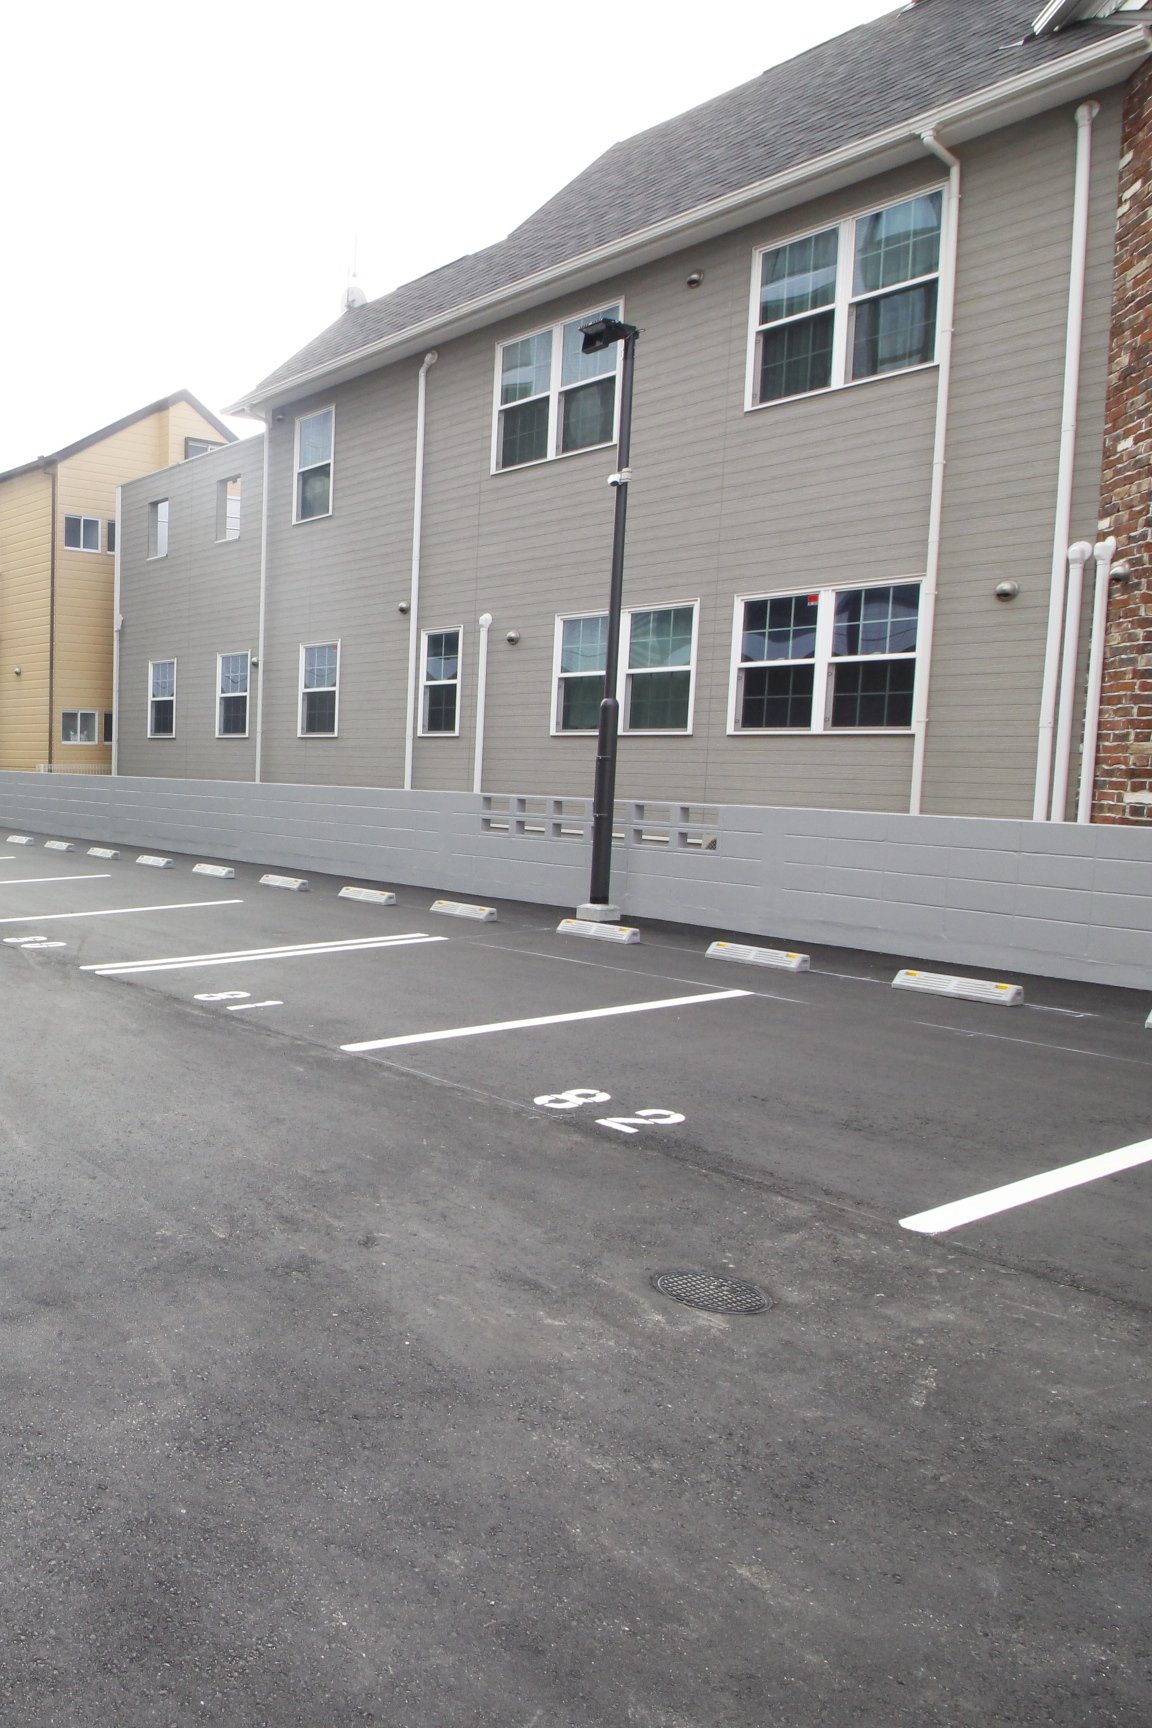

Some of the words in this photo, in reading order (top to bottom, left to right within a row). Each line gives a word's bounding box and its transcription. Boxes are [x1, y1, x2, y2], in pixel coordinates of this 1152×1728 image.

[2, 935, 67, 949] 80
[193, 990, 284, 1011] 81
[533, 1088, 686, 1134] 82
